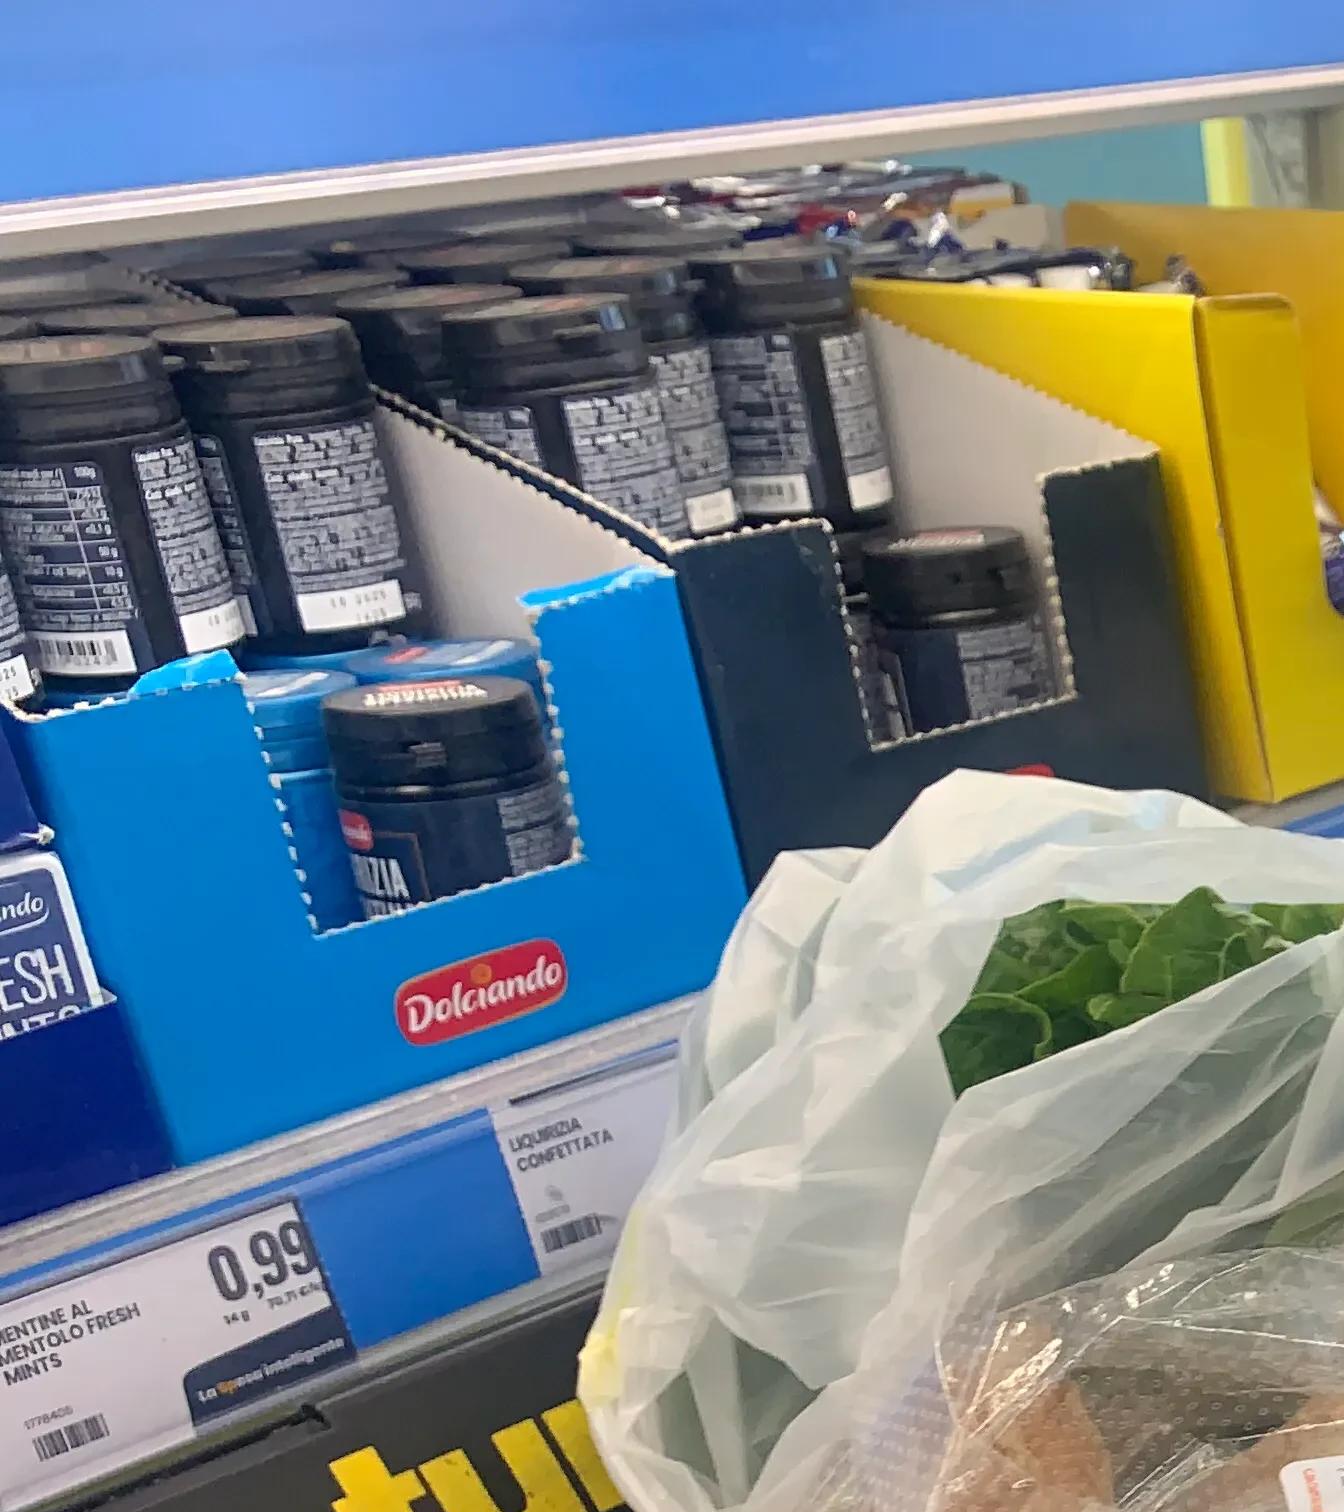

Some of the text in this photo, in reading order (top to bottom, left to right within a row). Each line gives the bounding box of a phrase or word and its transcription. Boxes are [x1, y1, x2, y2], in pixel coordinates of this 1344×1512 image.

[403, 954, 563, 1034] Dolciando
[508, 1117, 583, 1153] LIQUIRIZIA
[517, 1128, 614, 1172] CONFETTATA
[207, 1219, 319, 1303] 0,99
[71, 1299, 93, 1319] AL
[85, 1302, 141, 1335] FRESH
[3, 1352, 63, 1386] MINTS
